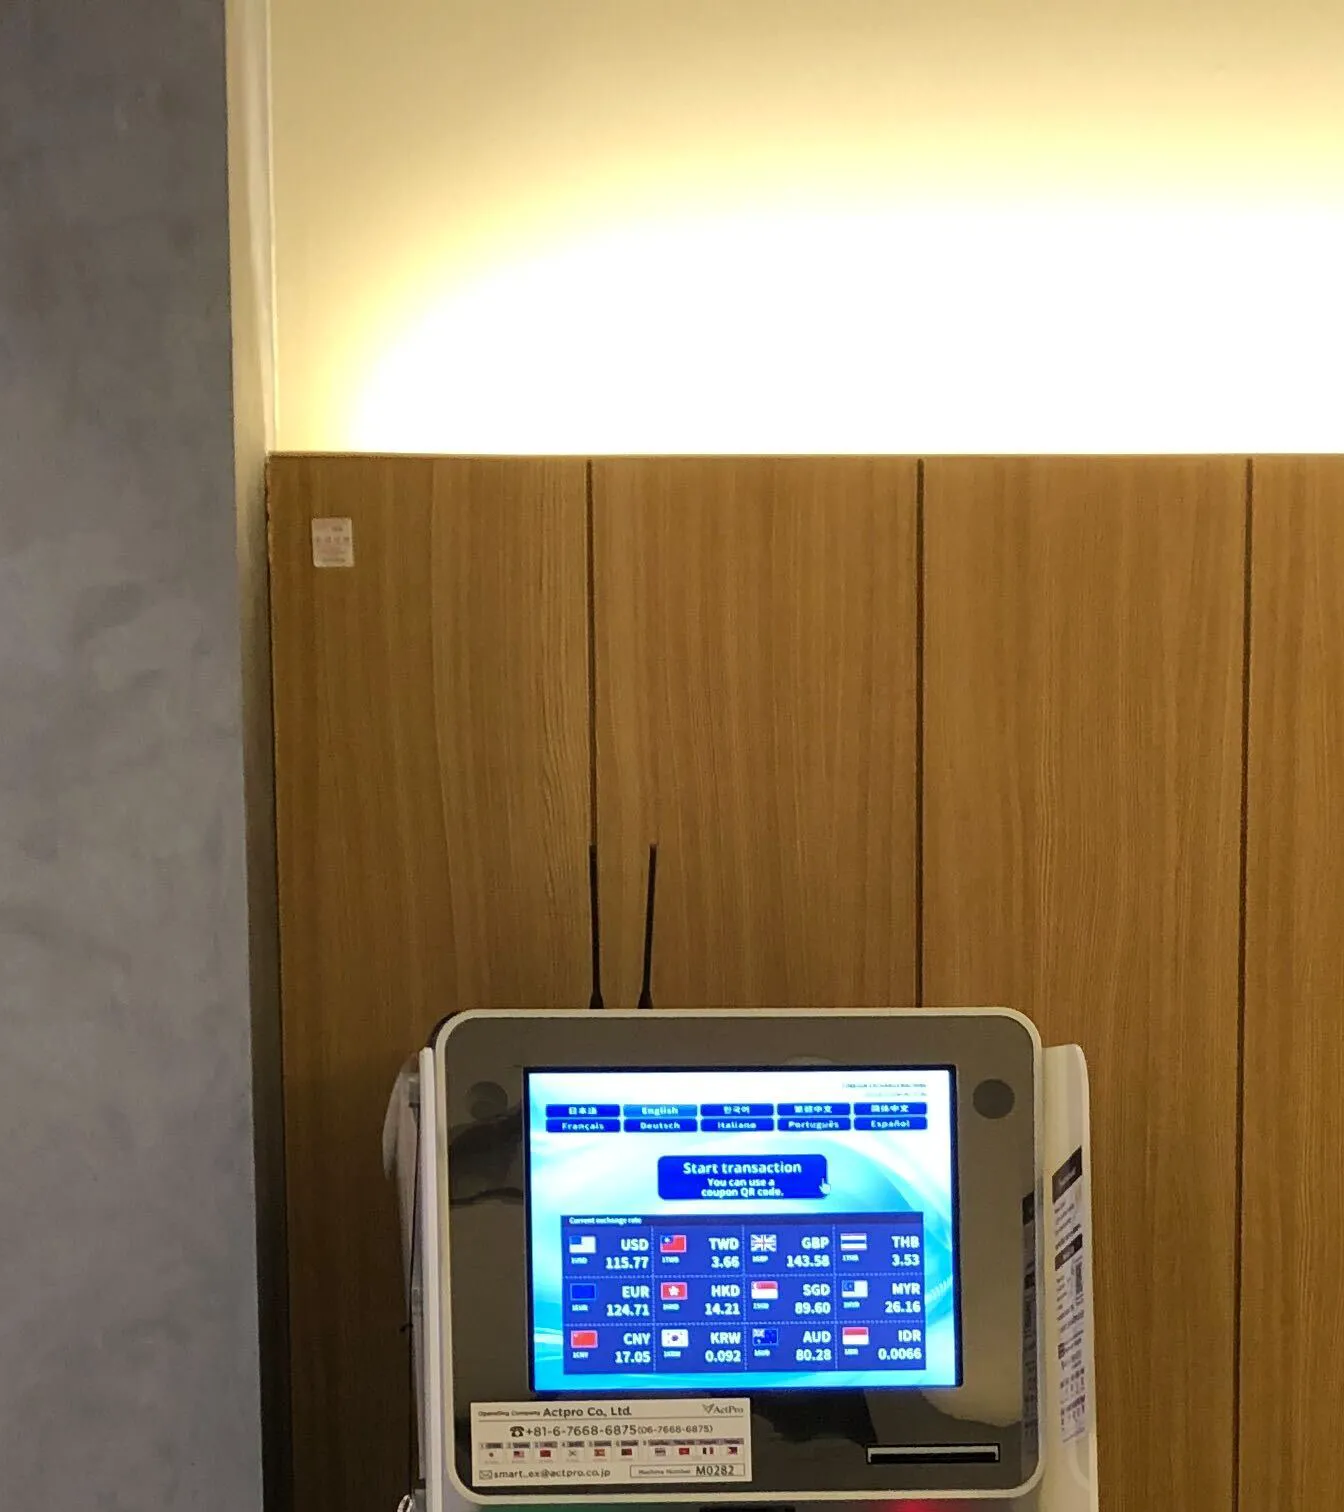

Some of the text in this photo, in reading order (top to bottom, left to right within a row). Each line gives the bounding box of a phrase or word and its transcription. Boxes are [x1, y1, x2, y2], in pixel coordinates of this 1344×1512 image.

[641, 1106, 679, 1117] English
[640, 1121, 681, 1130] Deutsch
[717, 1121, 757, 1130] Italiano
[870, 1119, 911, 1129] Español
[682, 1160, 803, 1175] Start transaction
[707, 1178, 776, 1187] You can use a
[701, 1187, 785, 1199] coupon QR code.
[620, 1238, 650, 1251] USD
[708, 1237, 740, 1251] TWD
[801, 1236, 830, 1249] GBP
[891, 1235, 920, 1249] THB
[606, 1256, 650, 1270] 115.77
[711, 1255, 741, 1269] 3.66
[786, 1254, 831, 1268] 143.58
[891, 1253, 920, 1267] 3.53
[621, 1285, 651, 1299] EUR
[710, 1284, 741, 1298] HKD
[802, 1283, 831, 1297] SGD
[891, 1282, 921, 1296] MYR
[606, 1303, 651, 1317] 124.71
[704, 1302, 741, 1316] 14.21
[794, 1301, 831, 1315] 89.60
[884, 1300, 922, 1314] 26.16
[623, 1332, 651, 1346] CNY
[709, 1331, 742, 1345] KRW
[802, 1330, 832, 1343] AUD
[897, 1329, 922, 1343] IDR
[614, 1350, 652, 1364] 17.05
[704, 1349, 742, 1363] 0.092
[795, 1348, 832, 1362] 80.28
[877, 1347, 923, 1361] 0.0066
[542, 1407, 584, 1420] Actpro
[696, 1464, 735, 1477] M0282
